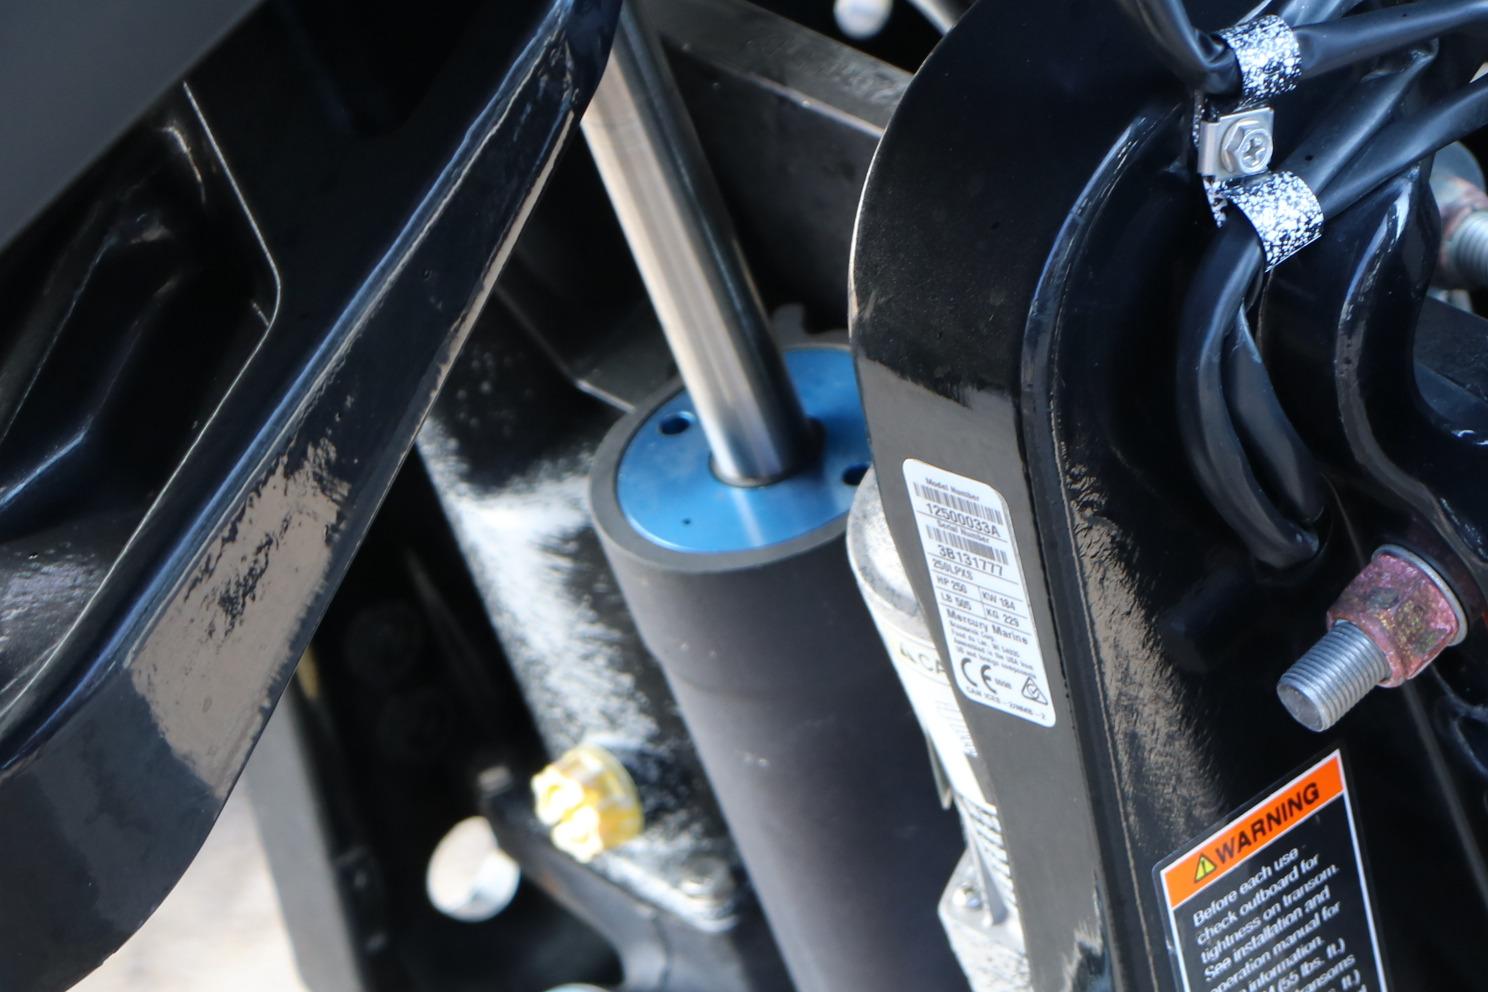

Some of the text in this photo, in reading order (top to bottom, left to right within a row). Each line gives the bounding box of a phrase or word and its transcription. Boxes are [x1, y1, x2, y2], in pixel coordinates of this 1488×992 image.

[925, 477, 979, 500] Model Number
[926, 503, 1000, 536] 12500033A
[937, 521, 989, 542] Serial Number
[938, 545, 1004, 576] 3B131777
[946, 609, 989, 632] Mercury
[992, 625, 1028, 645] Marine
[1215, 783, 1319, 863] WARNING
[1193, 848, 1298, 925] Before each use
[1196, 853, 1319, 945] check outboard for
[1200, 860, 1339, 965] tightness on transom.
[1204, 887, 1330, 981] See installation and
[1272, 914, 1320, 954] manual
[1322, 900, 1341, 920] for
[1248, 932, 1324, 992] information.
